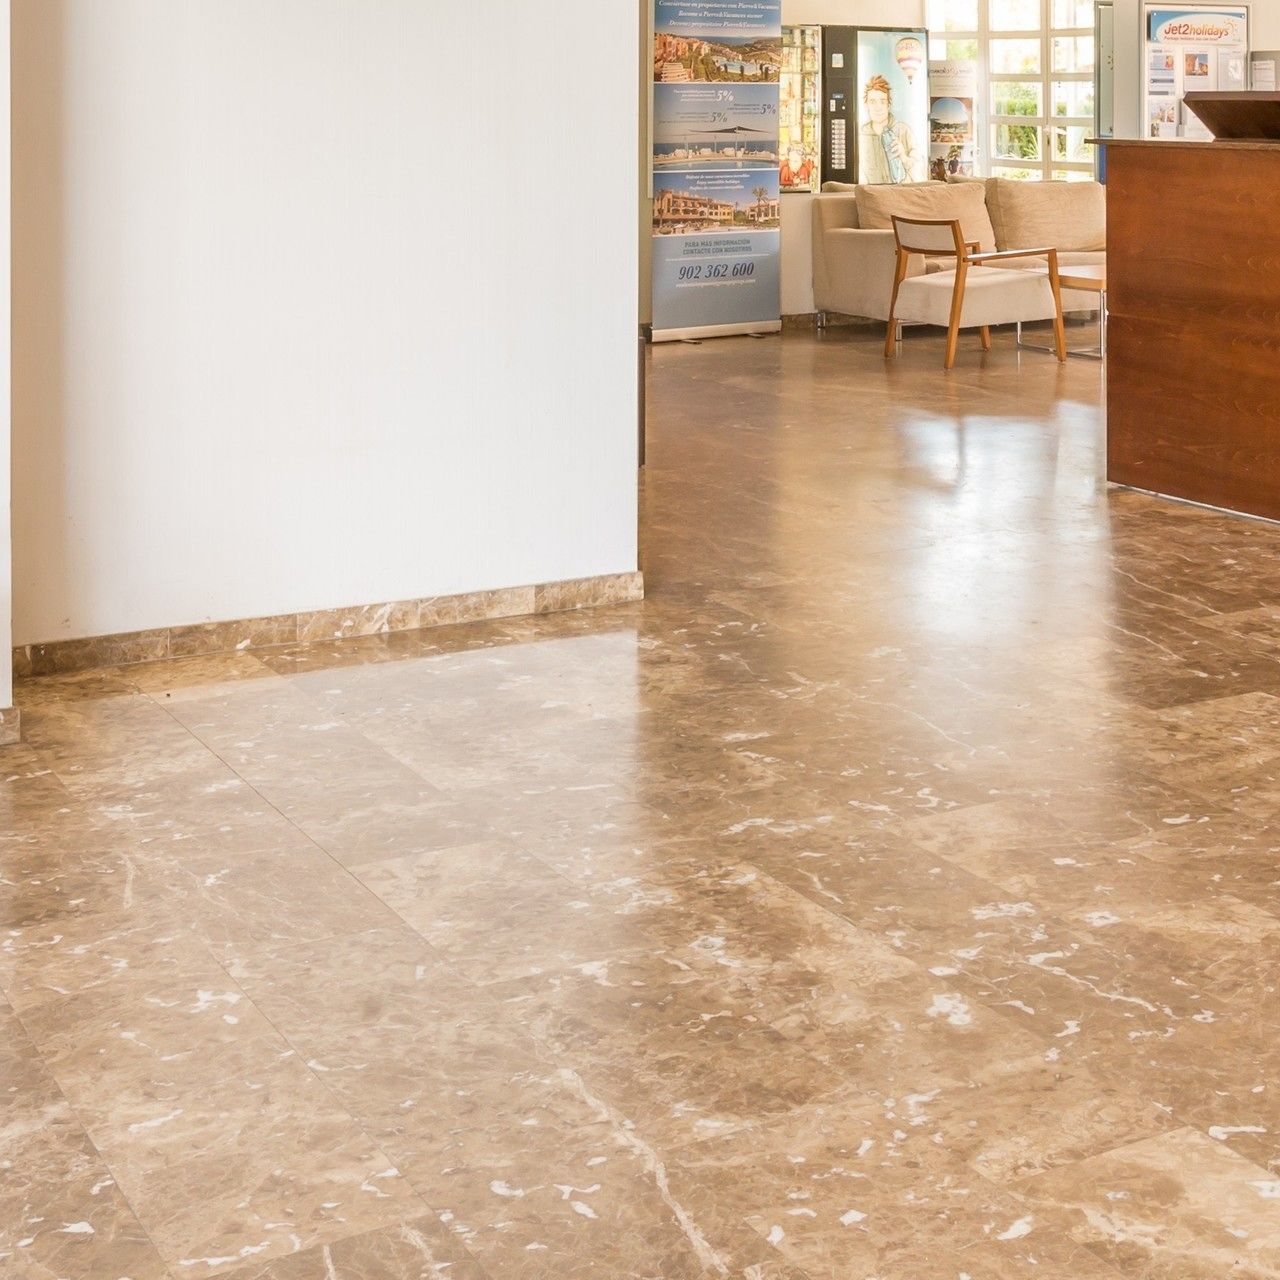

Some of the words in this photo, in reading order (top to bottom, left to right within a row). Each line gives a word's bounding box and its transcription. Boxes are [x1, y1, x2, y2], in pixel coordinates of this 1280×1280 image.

[715, 90, 735, 102] 5%
[760, 104, 776, 115] 5%
[711, 112, 728, 123] 5%
[678, 266, 702, 280] 902
[704, 264, 728, 278] 362
[732, 262, 754, 277] 600
